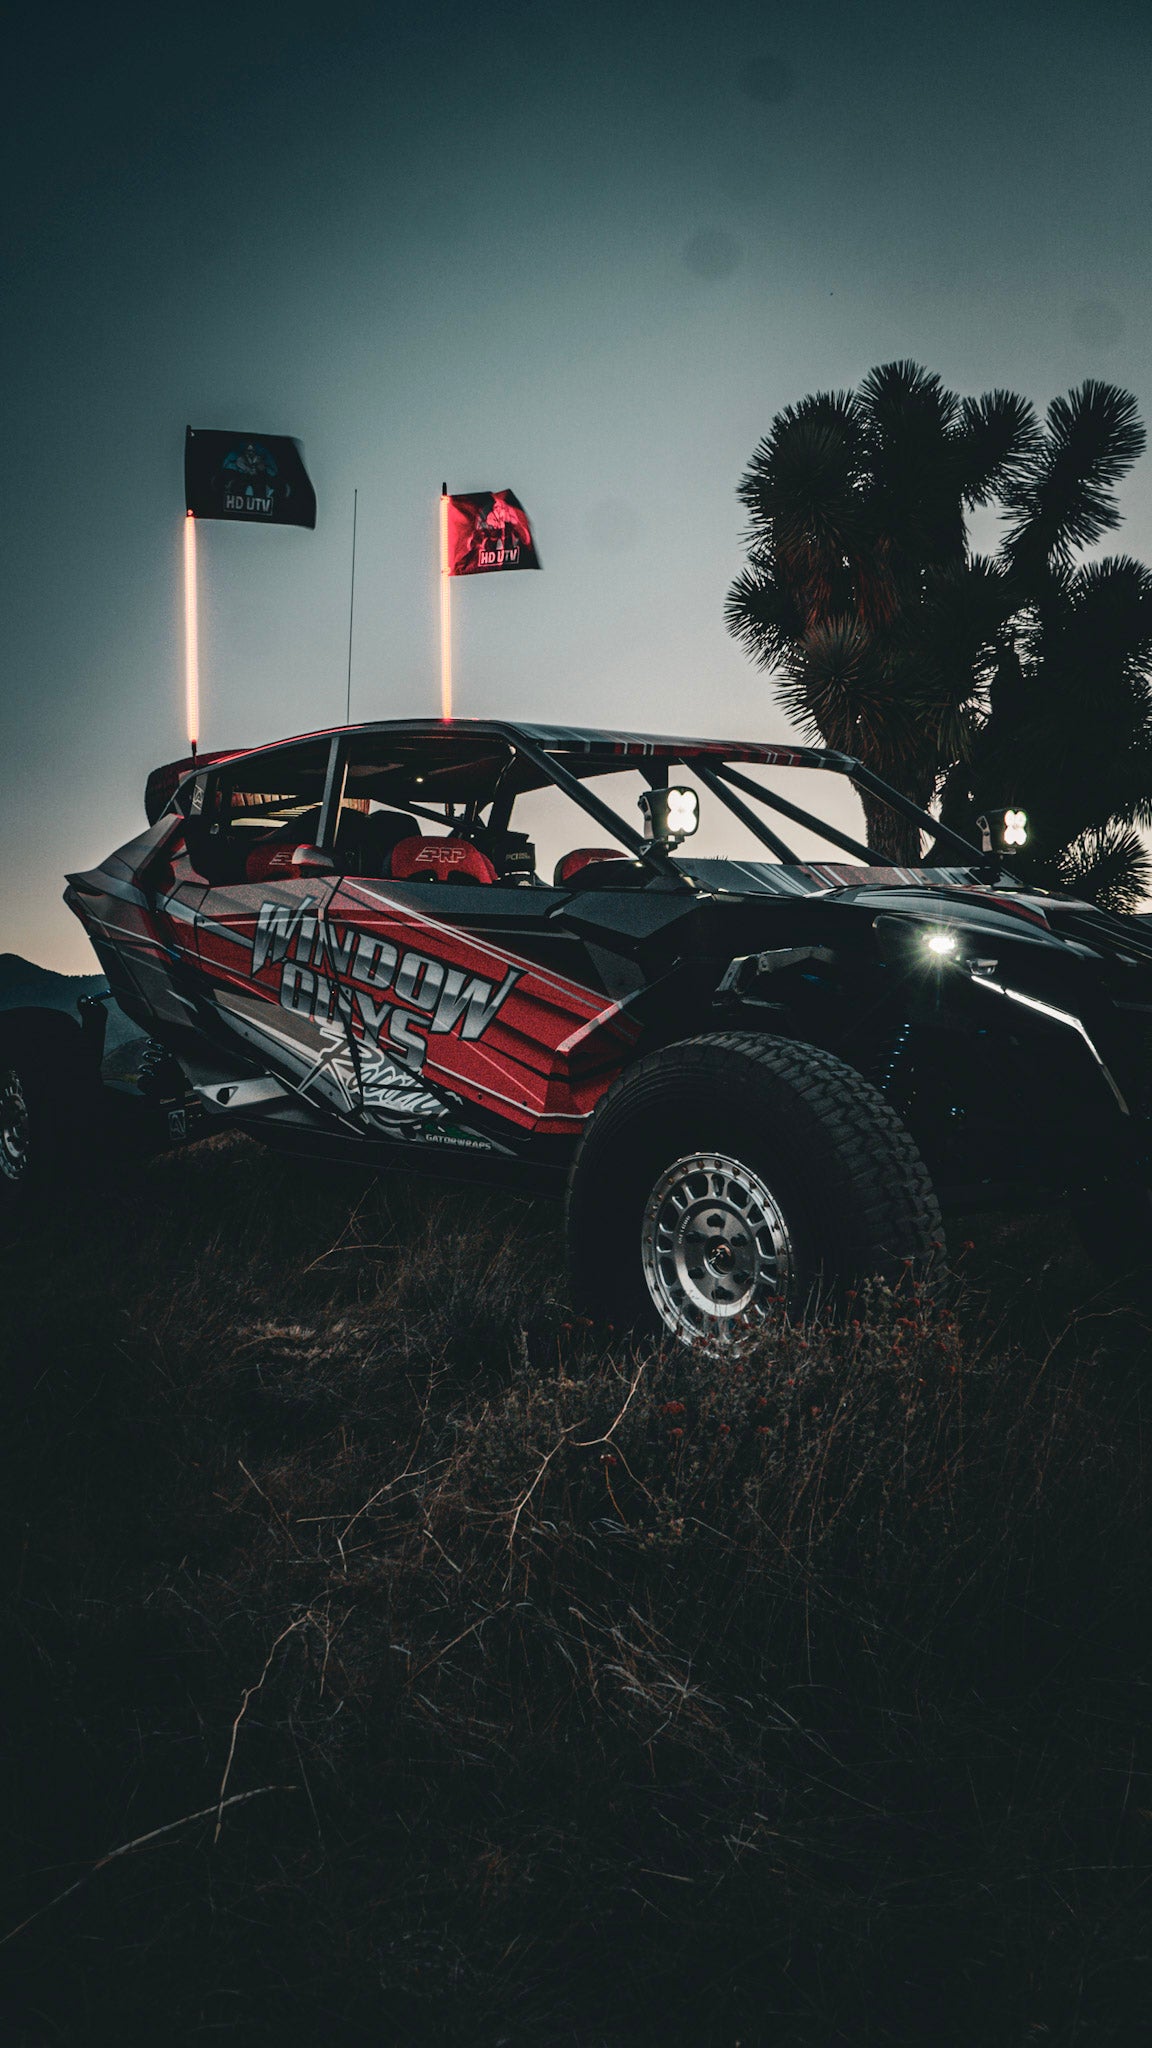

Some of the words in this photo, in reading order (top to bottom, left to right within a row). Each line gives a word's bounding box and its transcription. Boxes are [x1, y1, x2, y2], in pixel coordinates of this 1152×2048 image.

[226, 495, 244, 510] HD
[246, 497, 271, 513] UTV
[480, 551, 496, 564] HD
[497, 549, 518, 563] UTV
[251, 895, 529, 1042] WINDOW
[280, 961, 433, 1074] GUYS
[425, 1133, 492, 1151] GATORWRAPS
